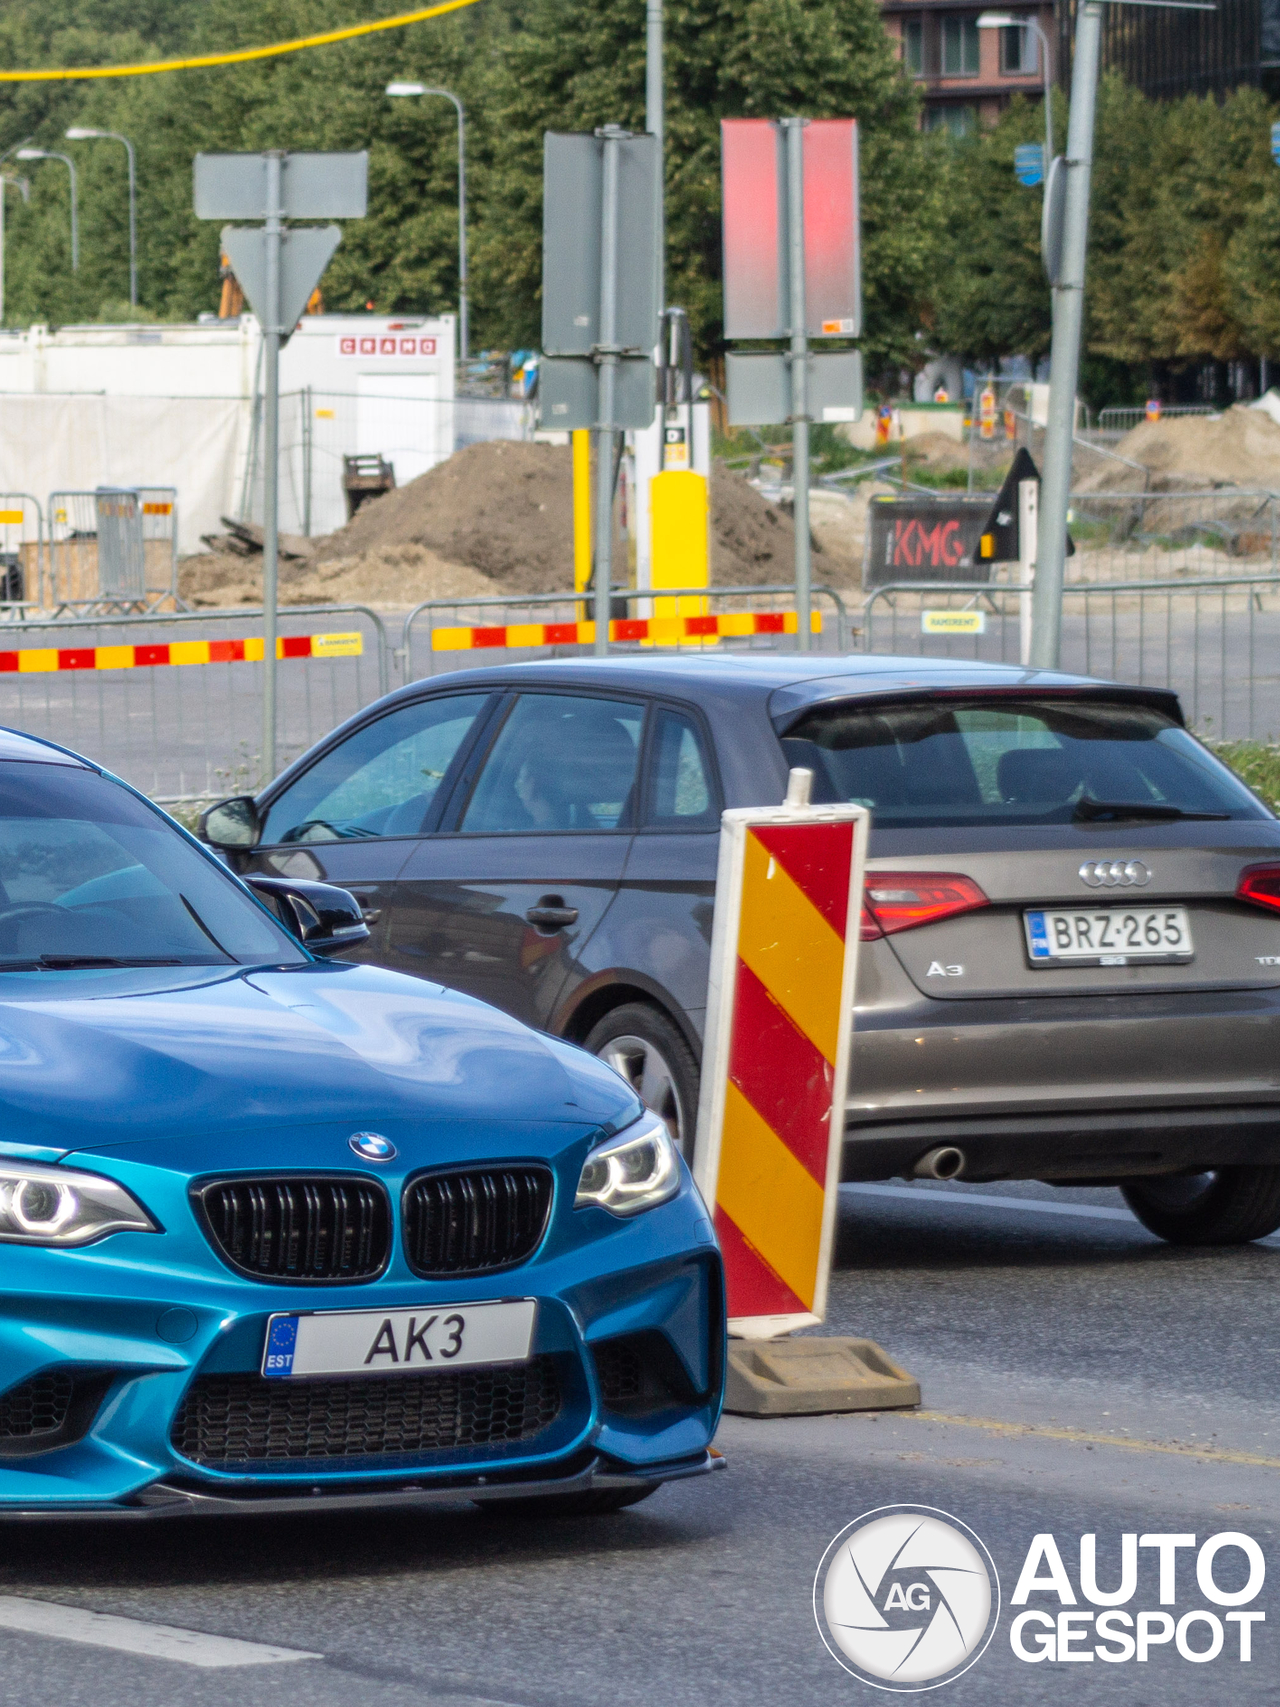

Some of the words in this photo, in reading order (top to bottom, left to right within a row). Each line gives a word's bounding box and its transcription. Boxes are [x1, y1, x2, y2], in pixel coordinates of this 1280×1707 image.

[340, 338, 436, 355] CRAMO
[893, 519, 965, 567] KMG
[1053, 913, 1182, 950] BRZ-265
[1032, 938, 1048, 948] FIN
[926, 961, 964, 977] A3
[363, 1312, 466, 1365] AK3
[266, 1354, 293, 1369] EST
